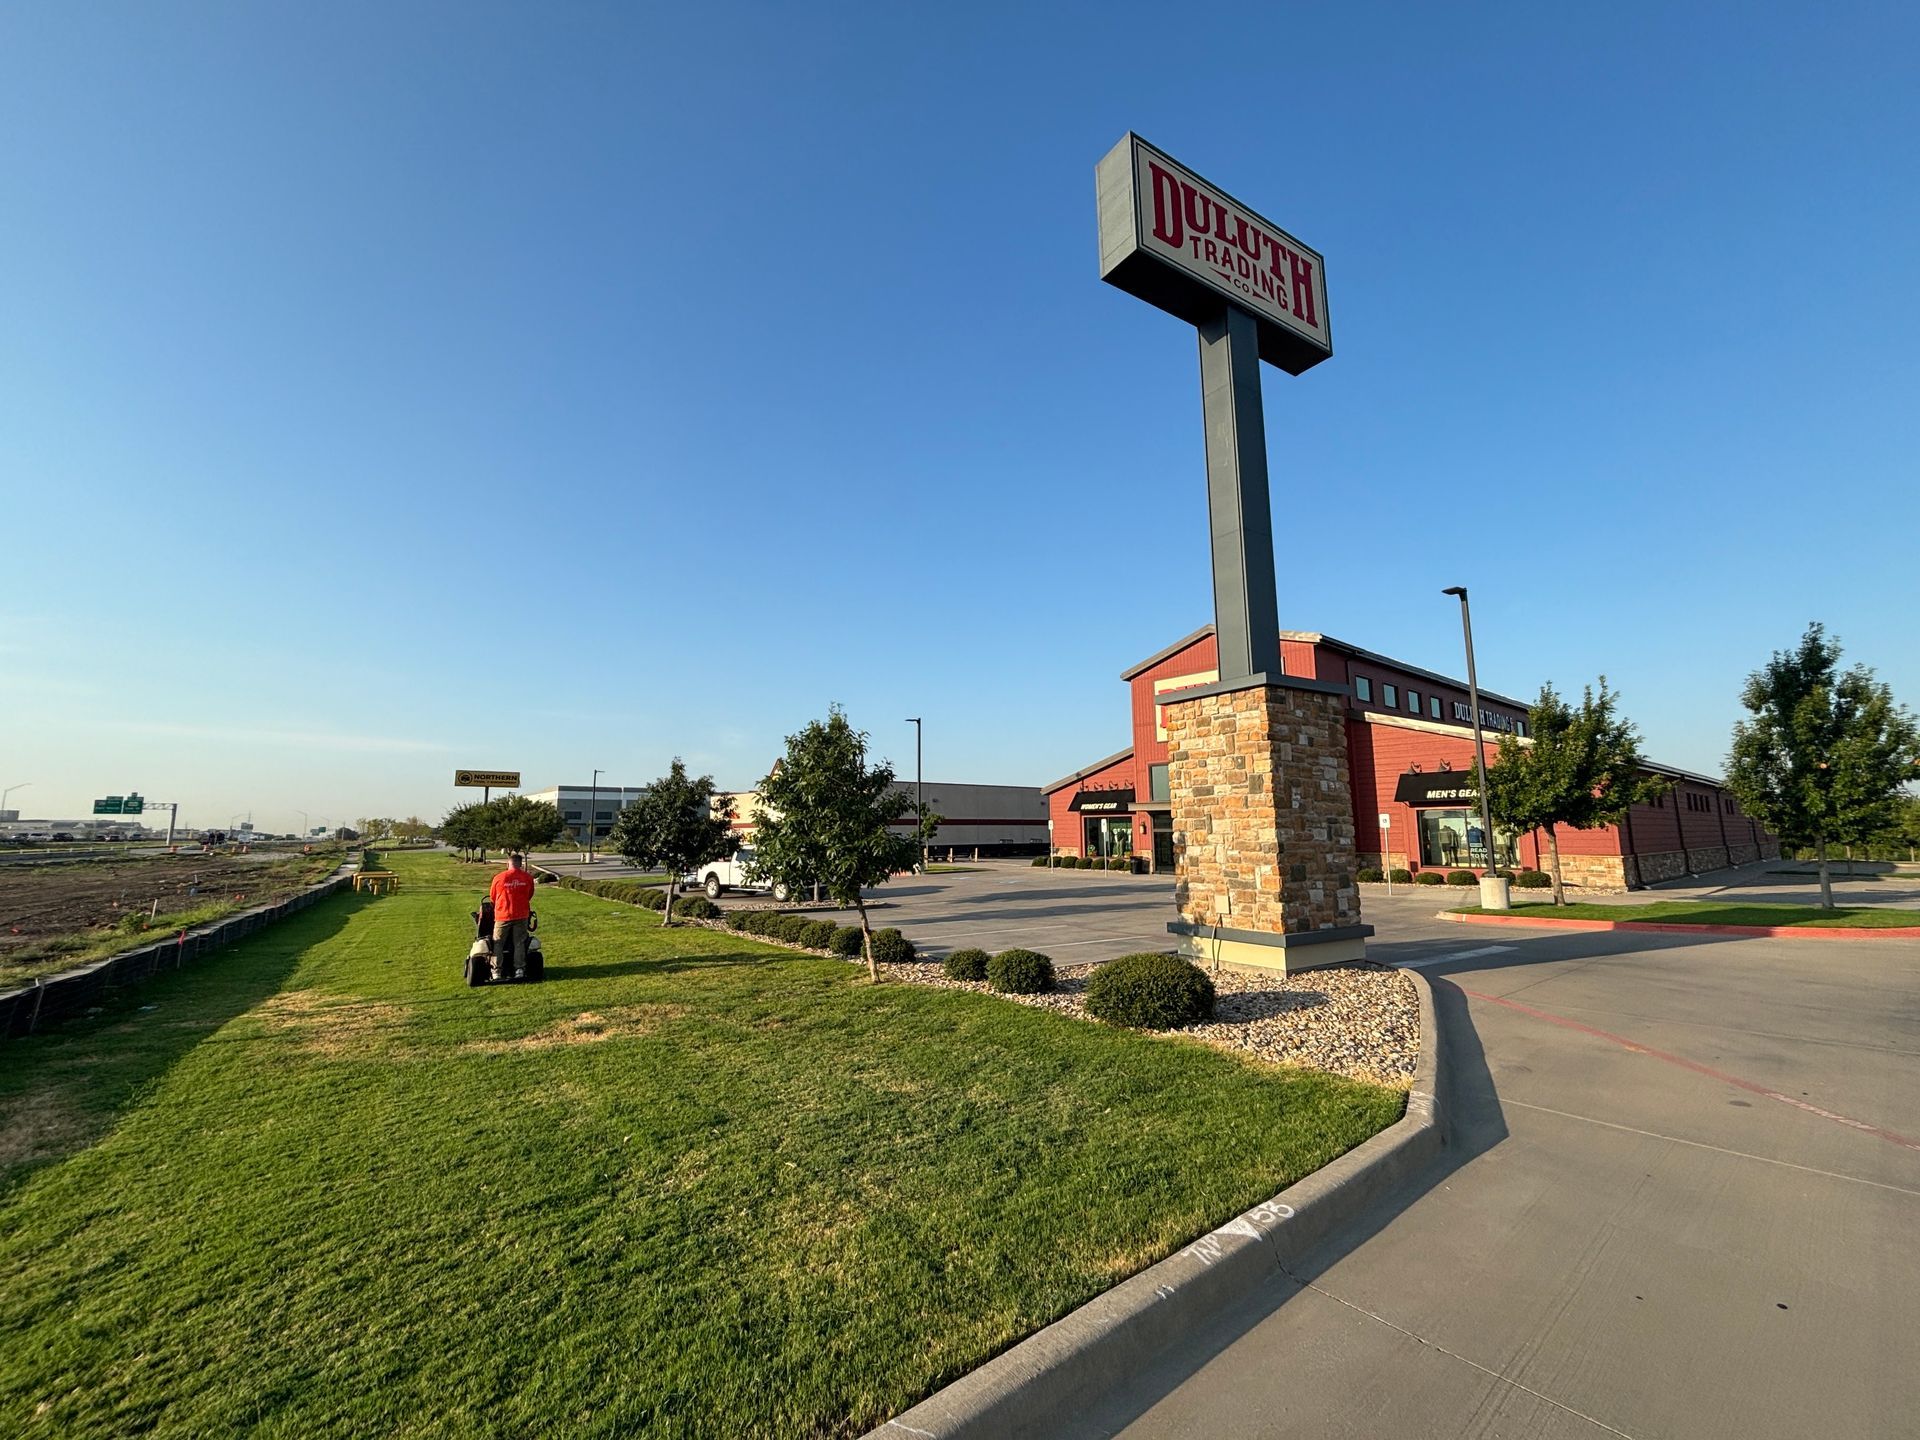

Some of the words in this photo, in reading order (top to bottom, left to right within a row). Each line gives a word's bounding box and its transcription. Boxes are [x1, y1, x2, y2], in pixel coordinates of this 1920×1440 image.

[1149, 160, 1318, 328] DULUTH
[1189, 235, 1289, 311] TRADING
[1233, 278, 1250, 293] CO
[1427, 789, 1456, 799] MEN'S
[1458, 789, 1480, 798] GEA
